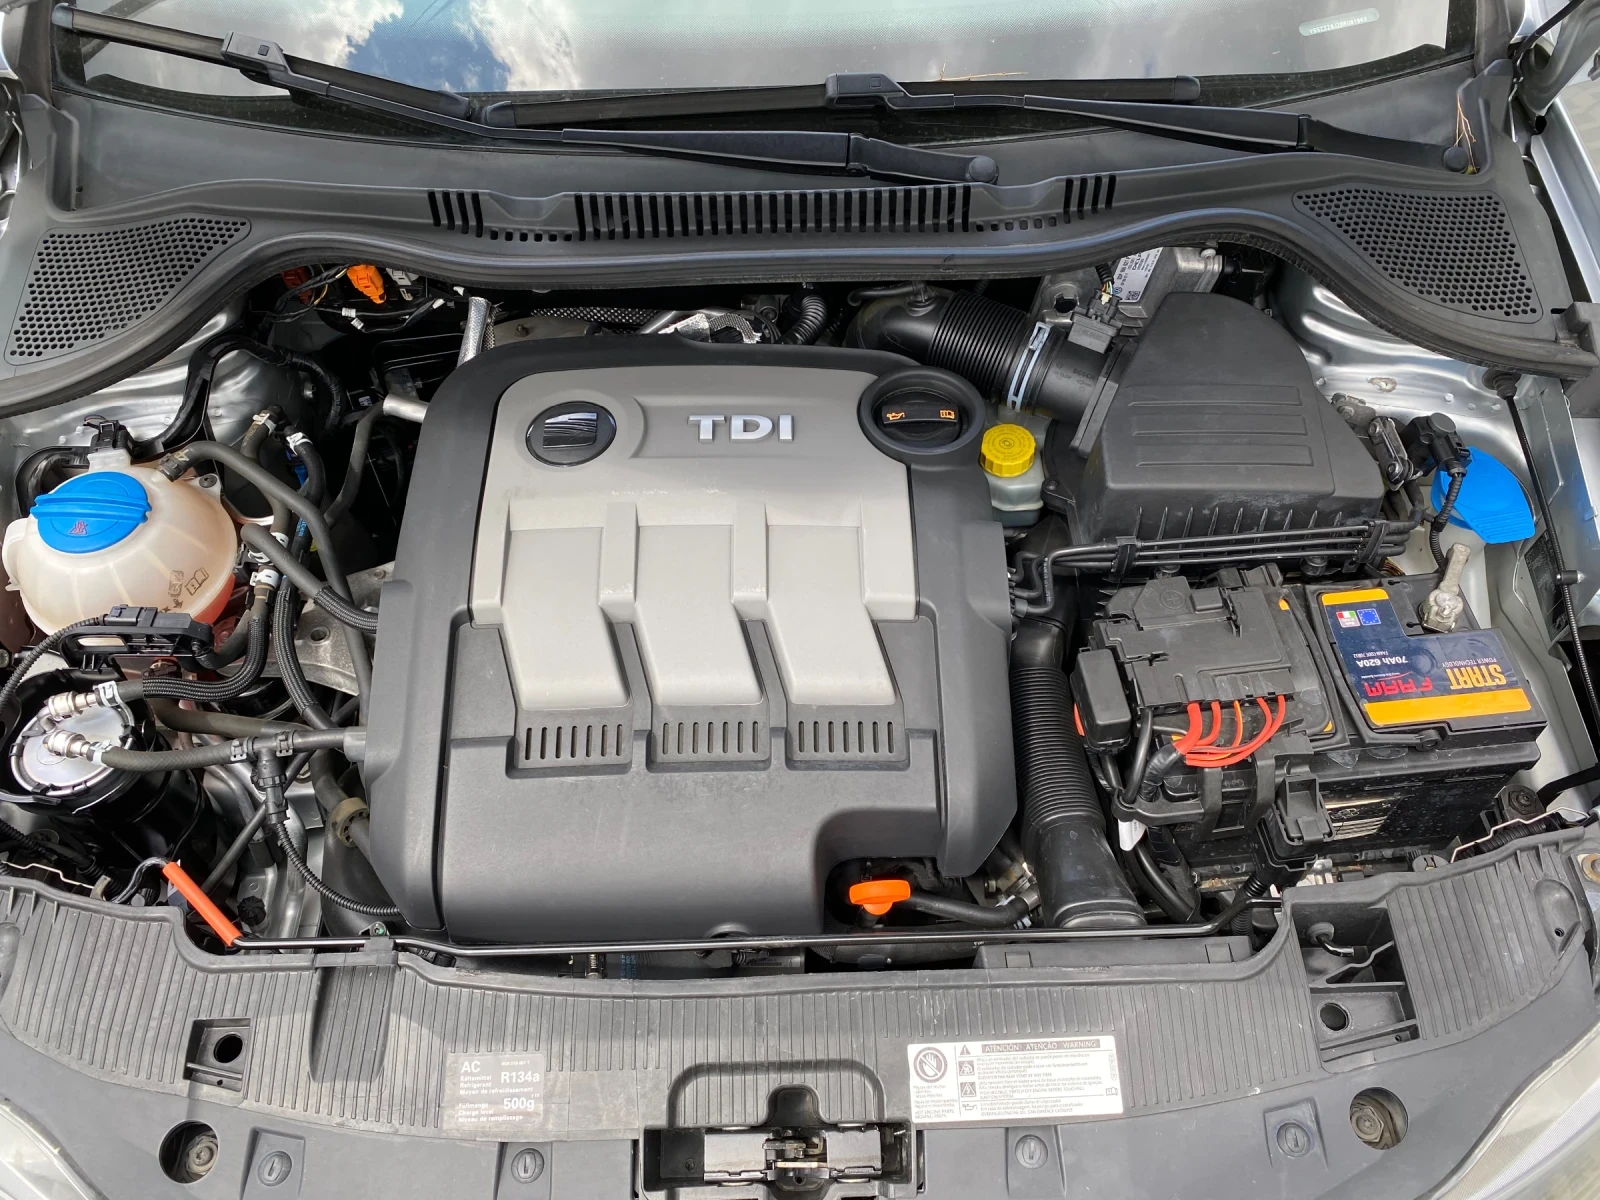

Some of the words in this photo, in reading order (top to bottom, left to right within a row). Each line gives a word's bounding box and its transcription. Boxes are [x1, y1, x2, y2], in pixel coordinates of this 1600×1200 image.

[688, 414, 793, 441] TDI
[1356, 658, 1380, 667] 620A
[1382, 656, 1408, 665] 70Ah
[1446, 664, 1507, 689] START
[1364, 677, 1433, 697] FAAM
[985, 1043, 1019, 1052] ATENCIÓN
[1026, 1041, 1057, 1051] ATENÇÃO
[1063, 1040, 1096, 1048] WARNING
[461, 1061, 480, 1073] AC
[501, 1071, 540, 1083] R134a
[503, 1097, 535, 1111] 500g
